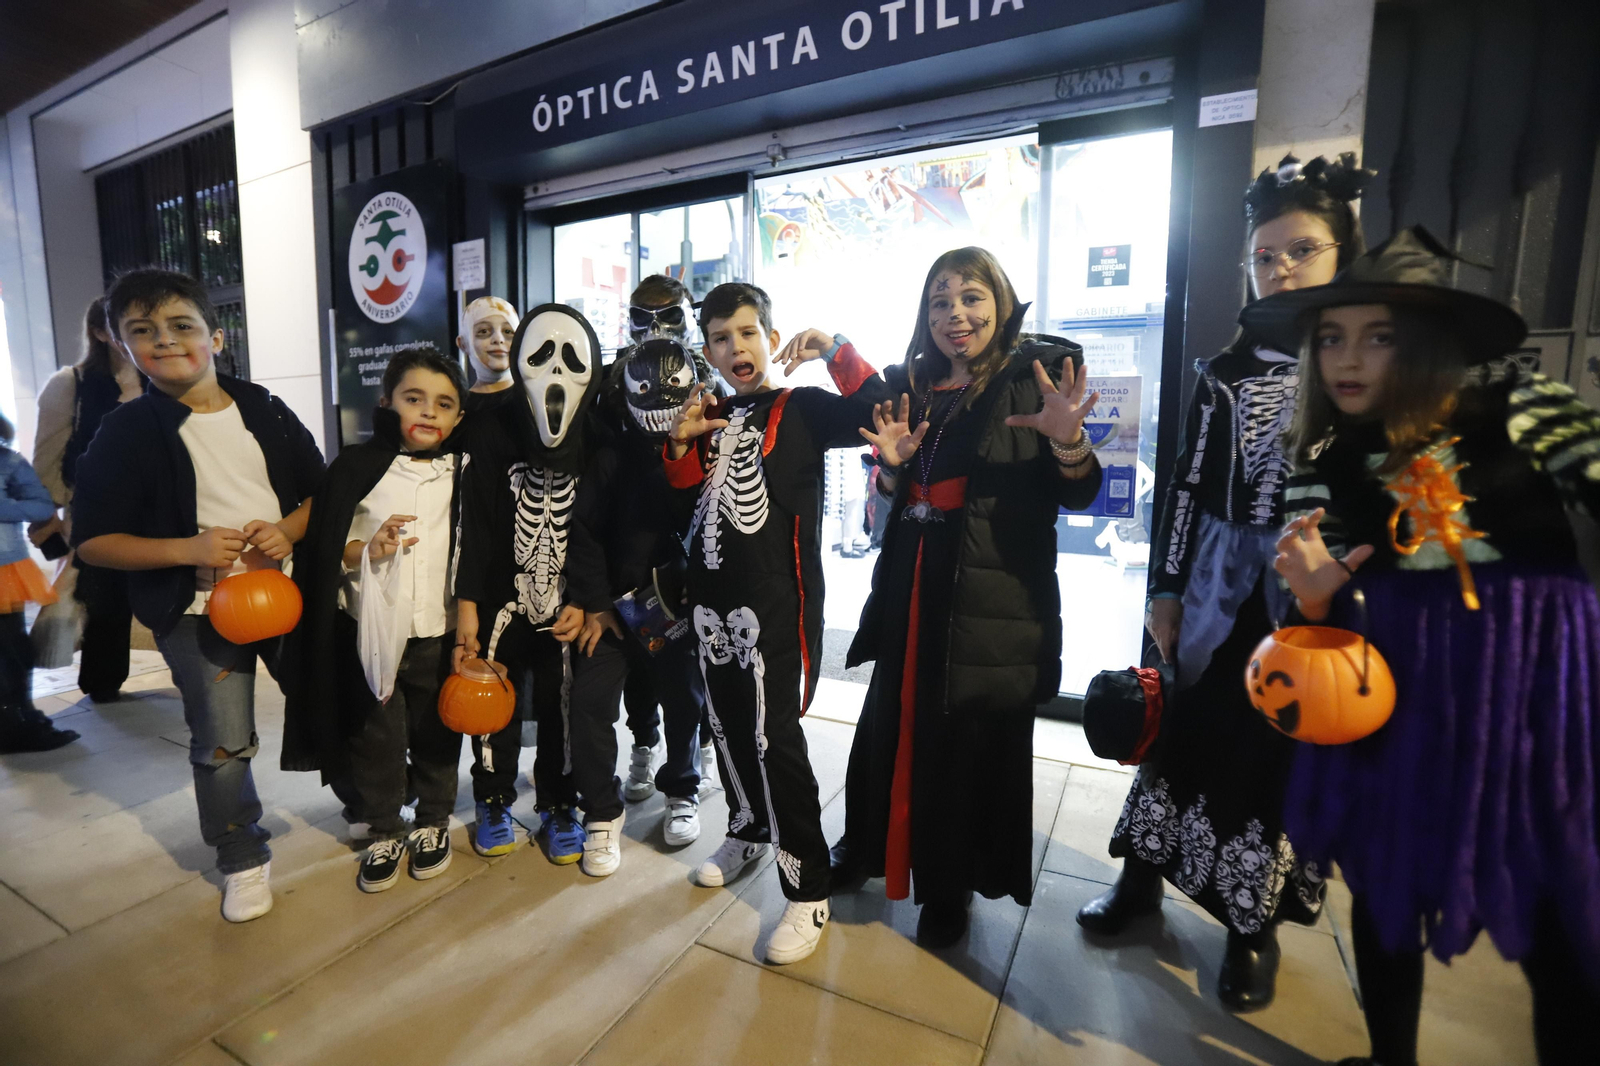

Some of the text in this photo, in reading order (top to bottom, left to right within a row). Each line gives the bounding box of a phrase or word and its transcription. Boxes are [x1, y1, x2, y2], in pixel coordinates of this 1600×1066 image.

[532, 69, 660, 133] ÓPTICA
[677, 25, 819, 94] SANTA
[1202, 95, 1255, 107] ESTABLECIMIENTO
[358, 196, 412, 229] SANTA OTILIA
[1091, 263, 1127, 272] CERTIFICADA
[361, 290, 414, 320] ANIVERSARIO
[1076, 306, 1128, 316] GABINETE
[349, 347, 364, 358] 55%
[364, 347, 374, 356] en
[374, 343, 394, 357] gafas
[361, 375, 381, 386] hasta
